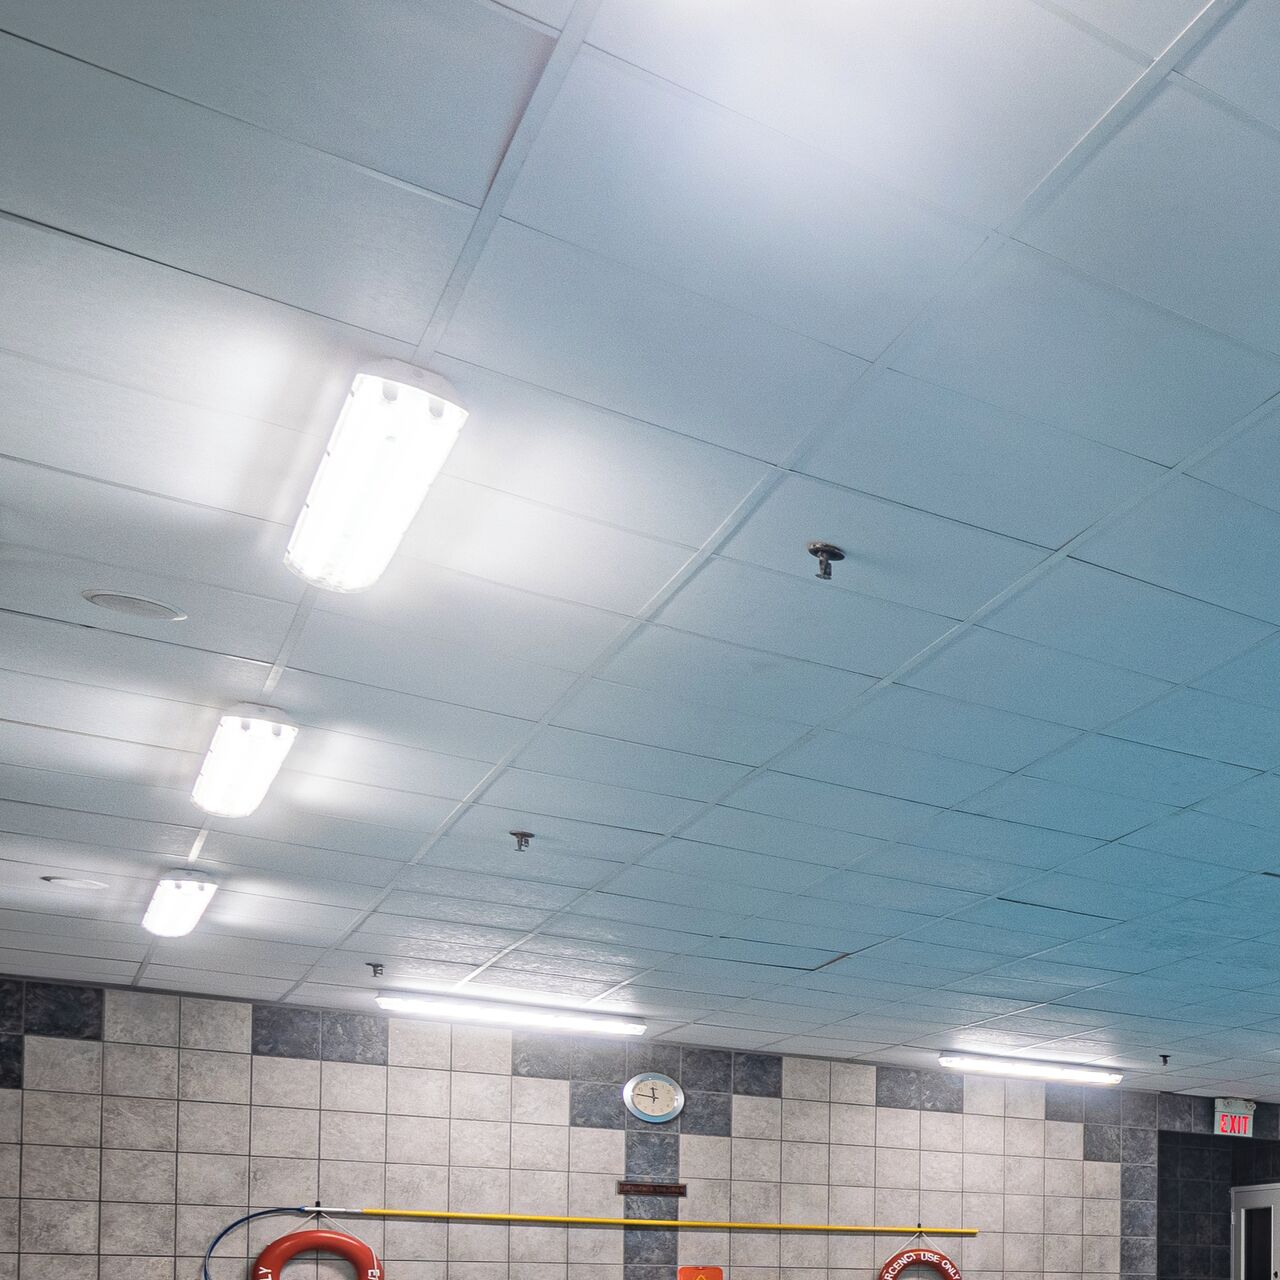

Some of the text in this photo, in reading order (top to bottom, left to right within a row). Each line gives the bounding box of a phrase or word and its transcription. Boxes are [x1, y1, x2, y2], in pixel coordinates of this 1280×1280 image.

[1220, 1113, 1249, 1135] EXIT
[920, 1252, 940, 1264] USE
[941, 1260, 961, 1280] ONLY
